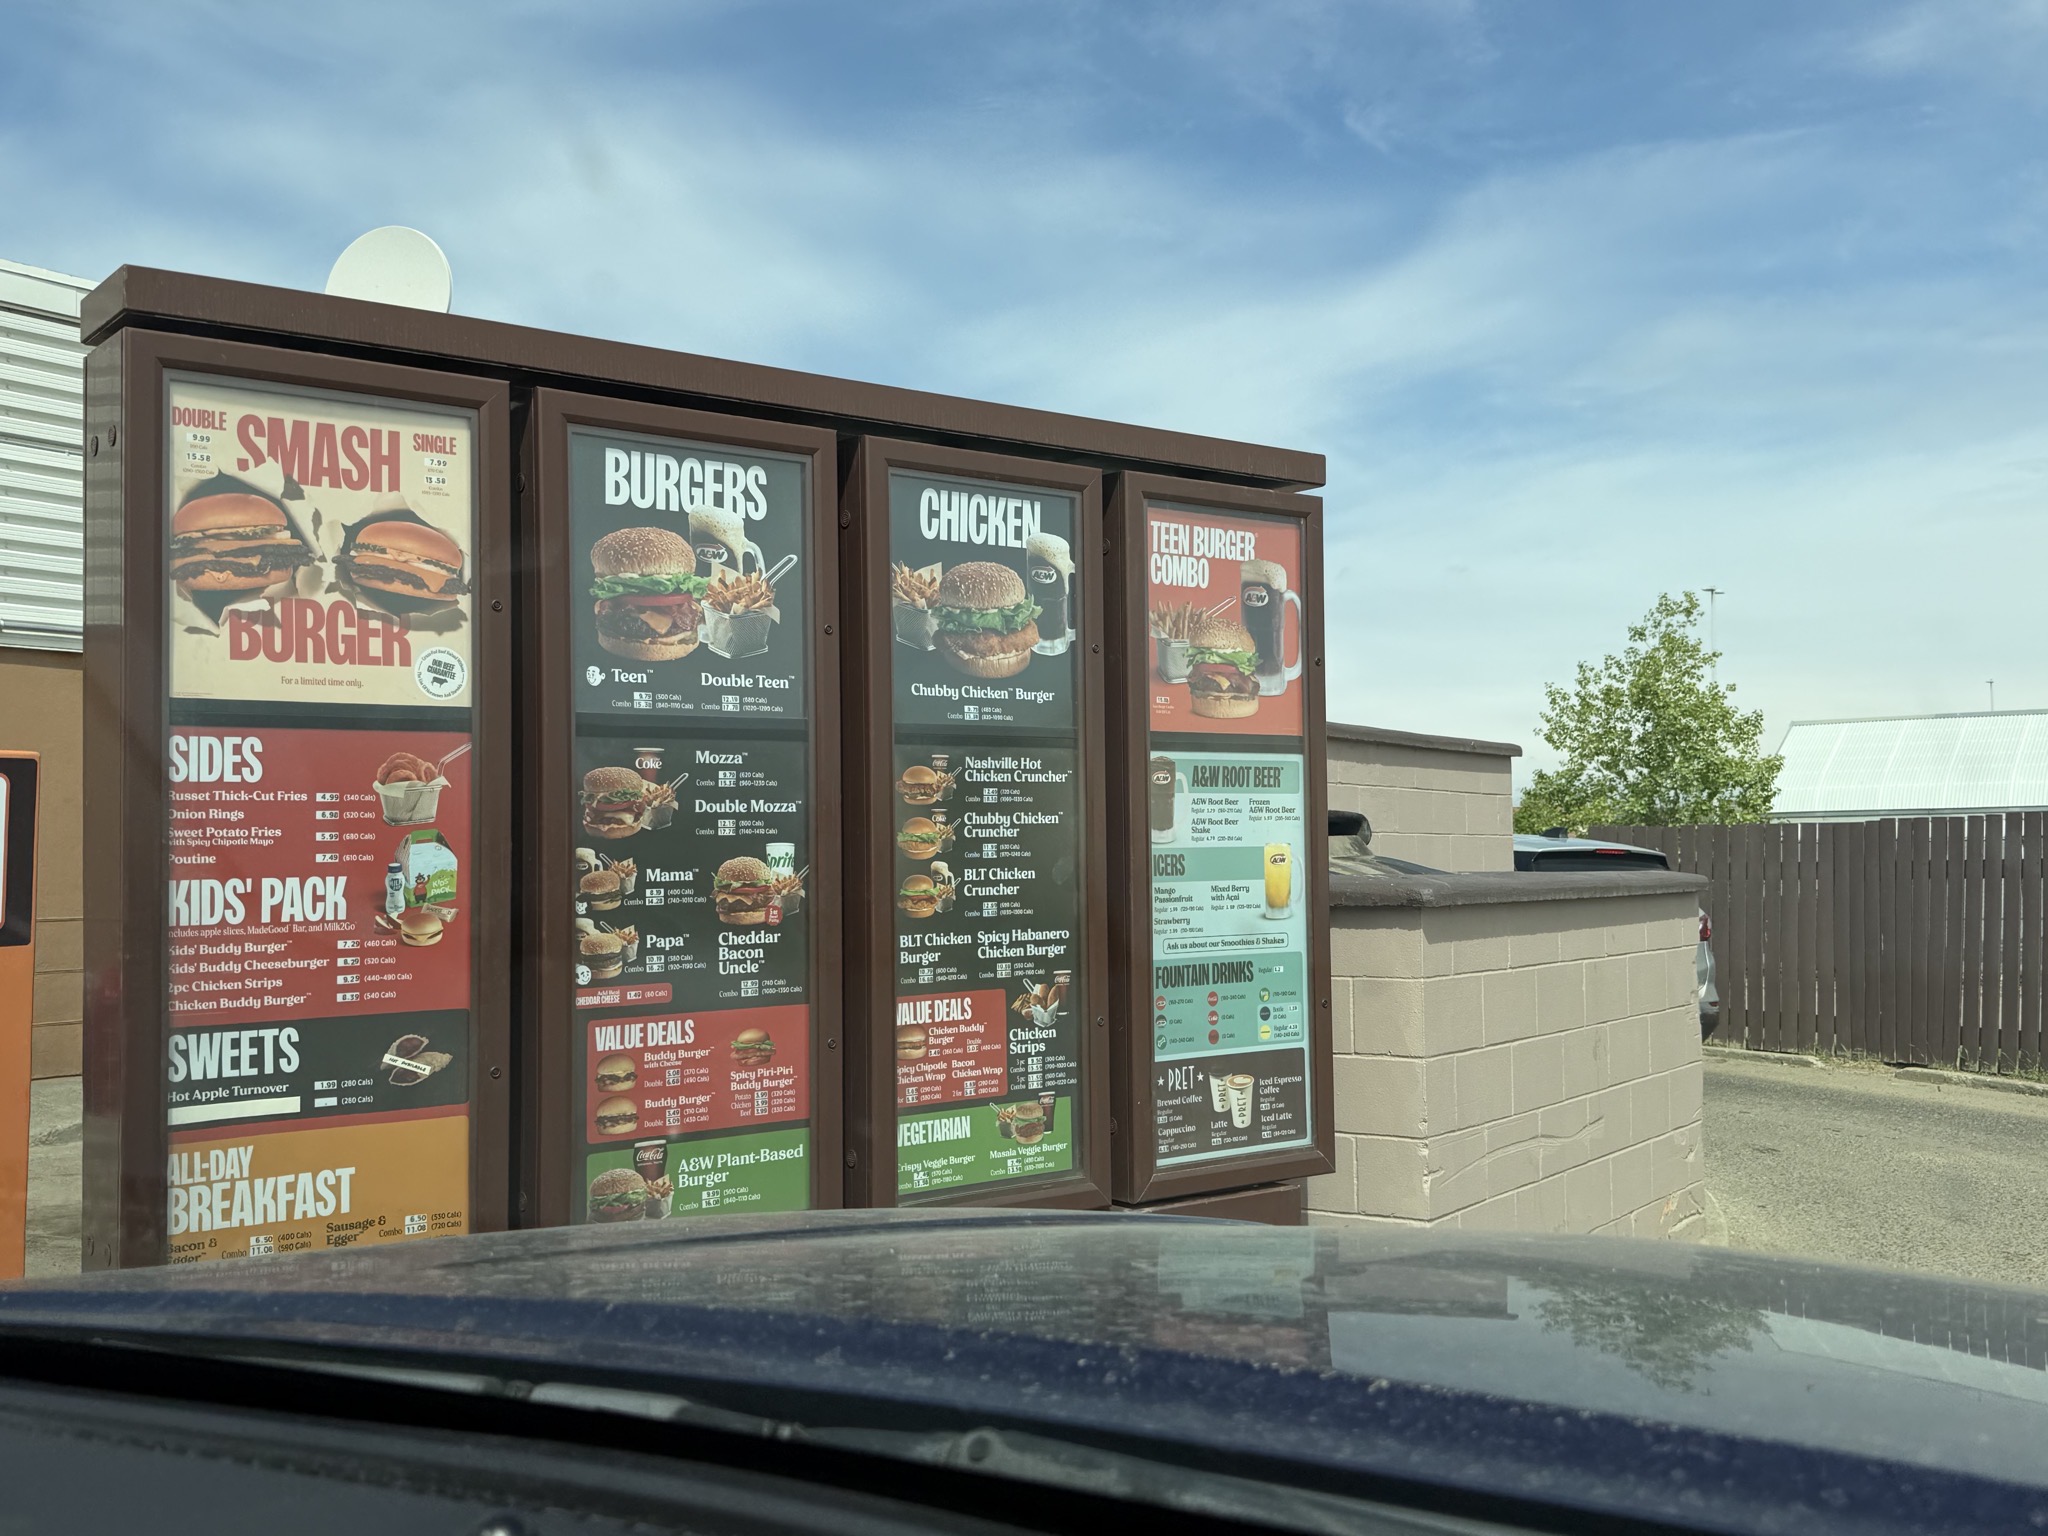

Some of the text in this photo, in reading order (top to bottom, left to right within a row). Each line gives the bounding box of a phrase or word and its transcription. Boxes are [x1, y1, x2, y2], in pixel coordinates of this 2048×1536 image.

[172, 406, 227, 431] DOUBLE
[192, 433, 211, 443] 9.99
[412, 433, 457, 456] SINGLE
[186, 452, 211, 462] 15.58
[236, 413, 401, 493] SMASH
[429, 458, 447, 467] 7.99
[605, 447, 768, 521] BURGERS
[919, 487, 1041, 549] CHICKEN
[1150, 520, 1255, 562] TEEN BURGER
[1150, 553, 1210, 589] COMBO
[229, 597, 412, 668] BURGER
[281, 676, 292, 685] For
[300, 676, 326, 686] limited
[328, 677, 344, 687] time
[345, 678, 364, 688] only.
[701, 672, 754, 688] Double
[911, 682, 959, 701] Chubby
[1015, 688, 1055, 704] Burger
[169, 735, 263, 783] SIDES
[965, 756, 1042, 770] Nashville Hot
[964, 769, 1012, 782] Chicken
[1192, 765, 1281, 788] A&W ROOT BEER
[169, 790, 308, 801] Russet Thick-Cut Fries
[321, 793, 339, 801] 4.99
[695, 799, 748, 813] Double
[209, 808, 244, 822] Rings
[964, 812, 1011, 827] Chubby
[205, 826, 249, 838] Potato
[250, 826, 282, 838] Fries
[964, 826, 1020, 838] Cruncher
[187, 838, 274, 848] Spicy Chipotle Mayo
[169, 853, 217, 865] Poutine
[1153, 853, 1186, 877] ICERS
[964, 867, 1036, 881] BLT Chicken
[964, 884, 1020, 897] Cruncher
[169, 876, 347, 927] KIDS' PACK
[623, 898, 644, 906] Combo
[200, 927, 221, 939] apple
[718, 930, 782, 946] Cheddar
[899, 933, 972, 948] BLT Chicken
[977, 928, 1070, 945] Spicy Habanero
[199, 943, 242, 956] Buddy
[718, 947, 764, 961] Bacon
[977, 943, 1067, 959] Chicken Burger
[900, 951, 942, 965] Burger
[199, 960, 242, 974] Buddy
[244, 958, 330, 970] Cheeseburger
[1155, 961, 1254, 989] FOUNTAIN DRINKS
[191, 977, 283, 992] Chicken Strips
[169, 999, 217, 1011] Chicken
[219, 996, 261, 1010] Buddy
[897, 997, 972, 1026] VALUE DEALS
[595, 1019, 695, 1052] VALUE DEALS
[928, 1024, 985, 1036] Chicken Buddy
[1009, 1027, 1057, 1042] Chicken
[928, 1036, 955, 1046] Burger
[1009, 1040, 1046, 1056] Strips
[168, 1027, 300, 1083] SWEETS
[644, 1051, 677, 1063] Buddy
[915, 1061, 948, 1072] Chipotle
[951, 1059, 976, 1069] Bacon
[730, 1066, 794, 1082] Spicy Piri-Piri
[925, 1072, 947, 1081] Wrap
[951, 1066, 1003, 1079] Chicken Wrap
[1168, 1065, 1195, 1092] PRET
[730, 1079, 762, 1092] Buddy
[1259, 1075, 1303, 1086] Iced Espresso
[168, 1083, 289, 1102] Hot Apple Turnover
[1259, 1086, 1280, 1095] Coffee
[645, 1098, 677, 1110] Buddy
[1157, 1095, 1203, 1107] Brewed Coffee
[1237, 1097, 1247, 1118] PRET
[1210, 1120, 1228, 1129] Latte
[1261, 1112, 1293, 1123] Iced Latte
[898, 1115, 971, 1148] VEGETARIAN
[1157, 1124, 1197, 1137] Cappuccino
[989, 1142, 1068, 1160] Masala Veggie Burger
[168, 1145, 254, 1187] ALL-DAY
[678, 1144, 804, 1174] A&W Plant-Based
[922, 1154, 976, 1169] Veggie Burger
[678, 1170, 730, 1188] Burger
[167, 1167, 356, 1236] BREAKFAST
[326, 1217, 376, 1233] Sausage
[379, 1227, 403, 1238] Combo
[326, 1232, 360, 1248] Egger
